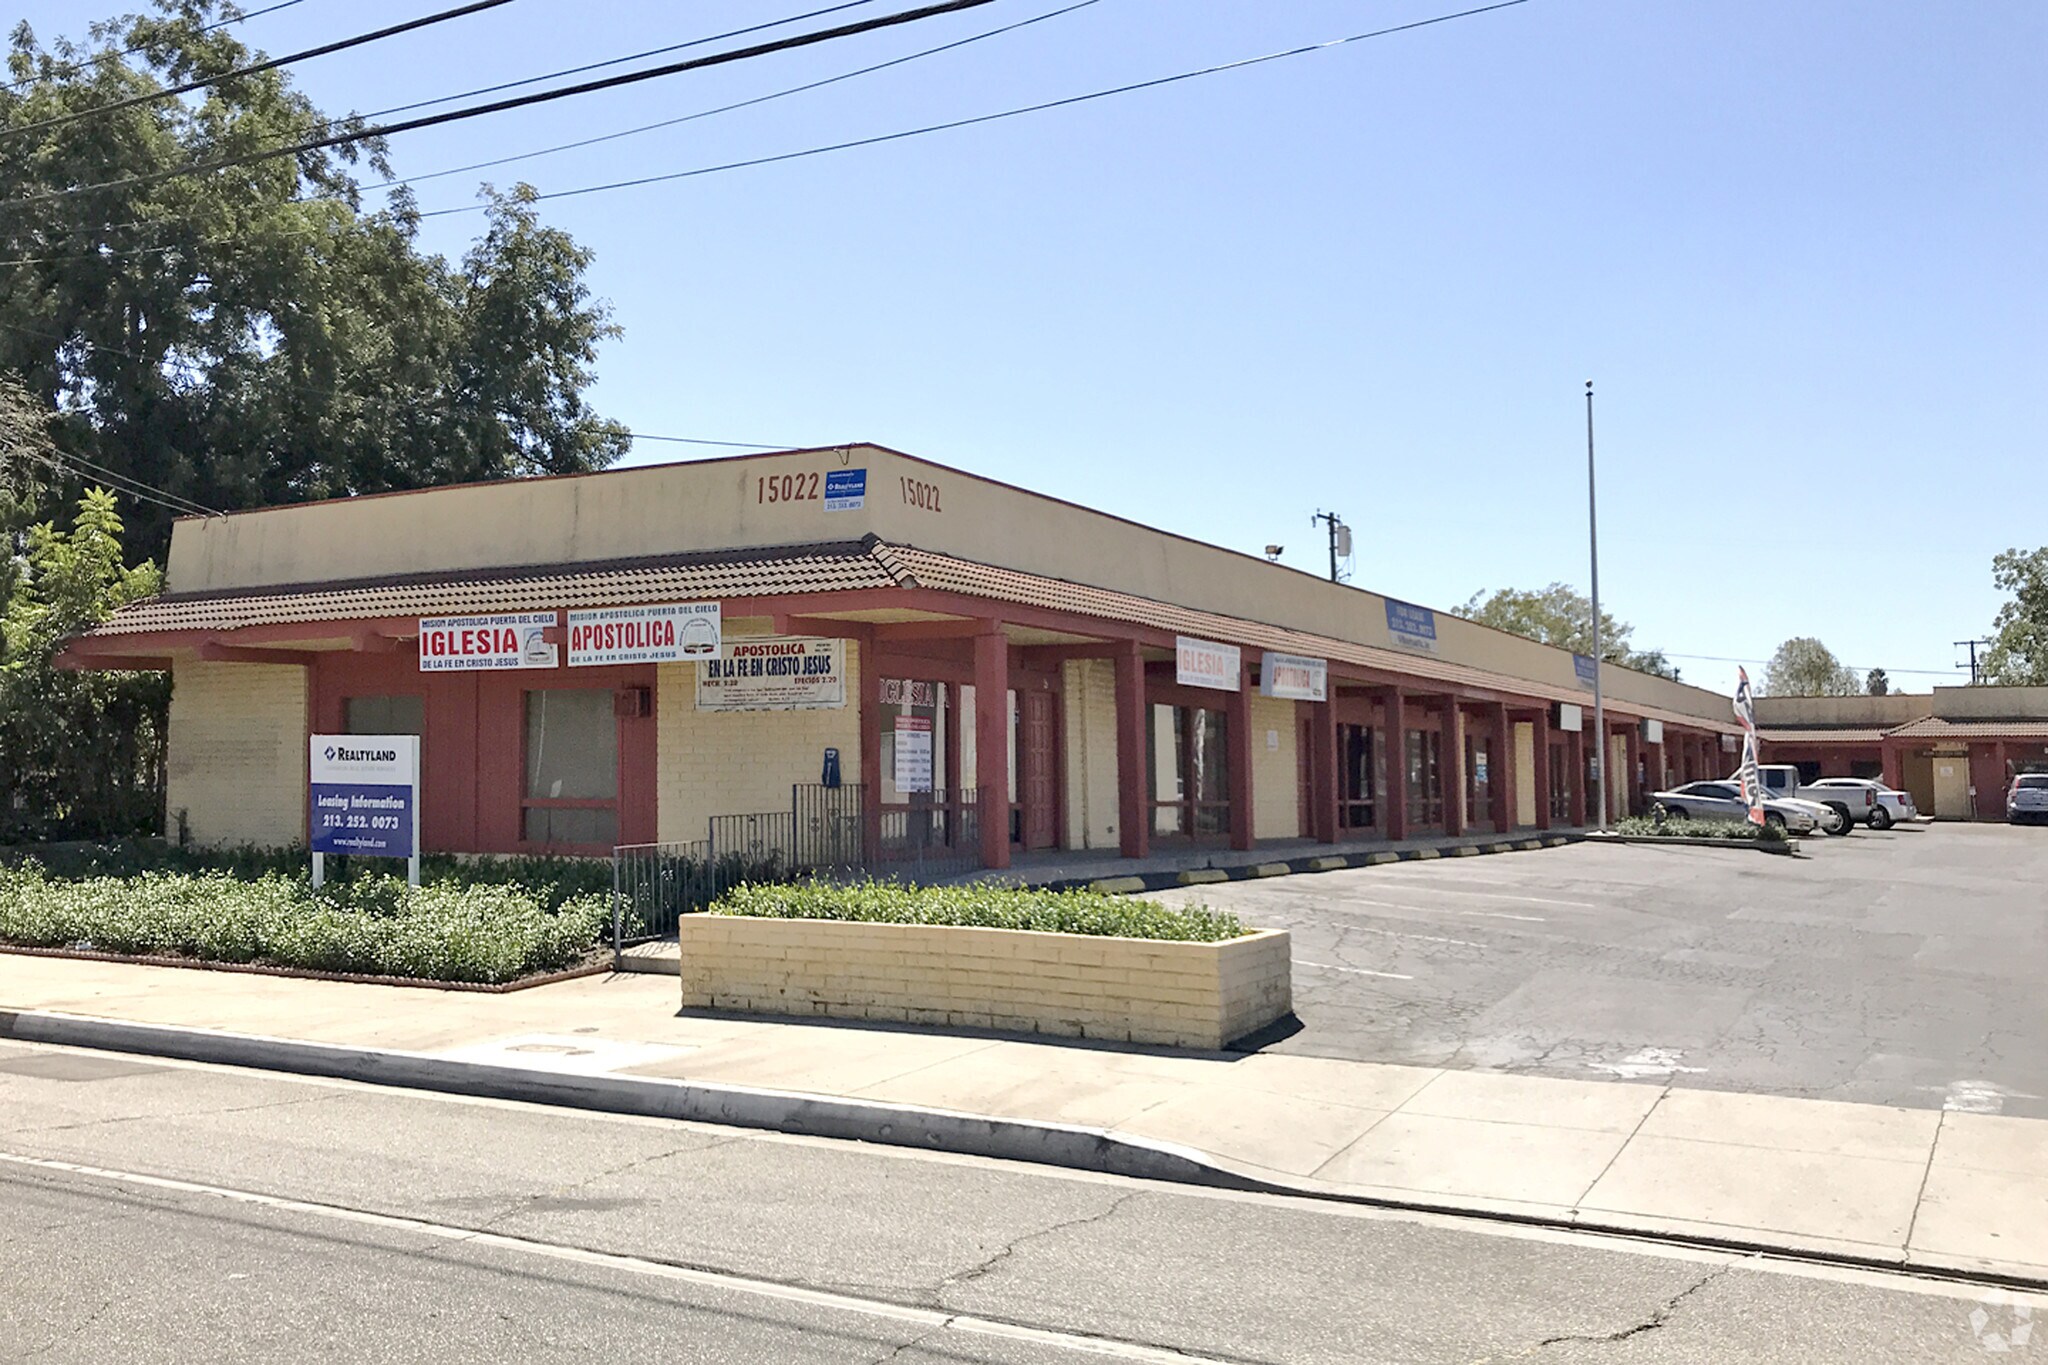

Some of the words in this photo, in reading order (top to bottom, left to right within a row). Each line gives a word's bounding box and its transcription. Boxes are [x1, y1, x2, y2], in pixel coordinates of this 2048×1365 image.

[758, 472, 819, 504] 15022
[900, 476, 942, 513] 15022
[422, 619, 446, 628] MISION
[448, 616, 489, 627] APOSTOLICA
[490, 615, 517, 625] PUERTA
[519, 614, 531, 624] DEL
[533, 613, 554, 623] CIELO
[570, 612, 597, 622] MISION
[600, 609, 645, 620] APOSTOLICA
[648, 606, 676, 617] PUERTA
[678, 605, 692, 614] DEL
[695, 604, 718, 614] CIELO
[422, 628, 519, 656] IGLESIA
[572, 619, 675, 651] APOSTOLICA
[570, 655, 580, 663] DE
[595, 654, 603, 662] FE
[606, 653, 617, 661] EN
[619, 652, 647, 661] CRISTO
[649, 650, 677, 659] JESUS
[733, 643, 806, 657] APOSTOLICA
[422, 660, 431, 669] DE
[433, 659, 443, 668] LA
[444, 659, 453, 668] FE
[455, 659, 465, 668] EN
[466, 658, 493, 668] CRISTO
[495, 657, 519, 667] JESUS
[708, 659, 720, 678] EN
[723, 659, 735, 678] LA
[738, 658, 748, 678] FE
[751, 658, 763, 677] EN
[766, 656, 800, 676] CRISTO
[802, 655, 831, 675] JESUS
[1178, 648, 1224, 676] IGLESIA
[338, 747, 396, 761] REALTYLAND
[318, 794, 349, 811] Leasing
[351, 794, 405, 809] Information
[323, 814, 344, 828] 213.
[346, 815, 368, 828] 252.
[372, 816, 399, 829] 0073
